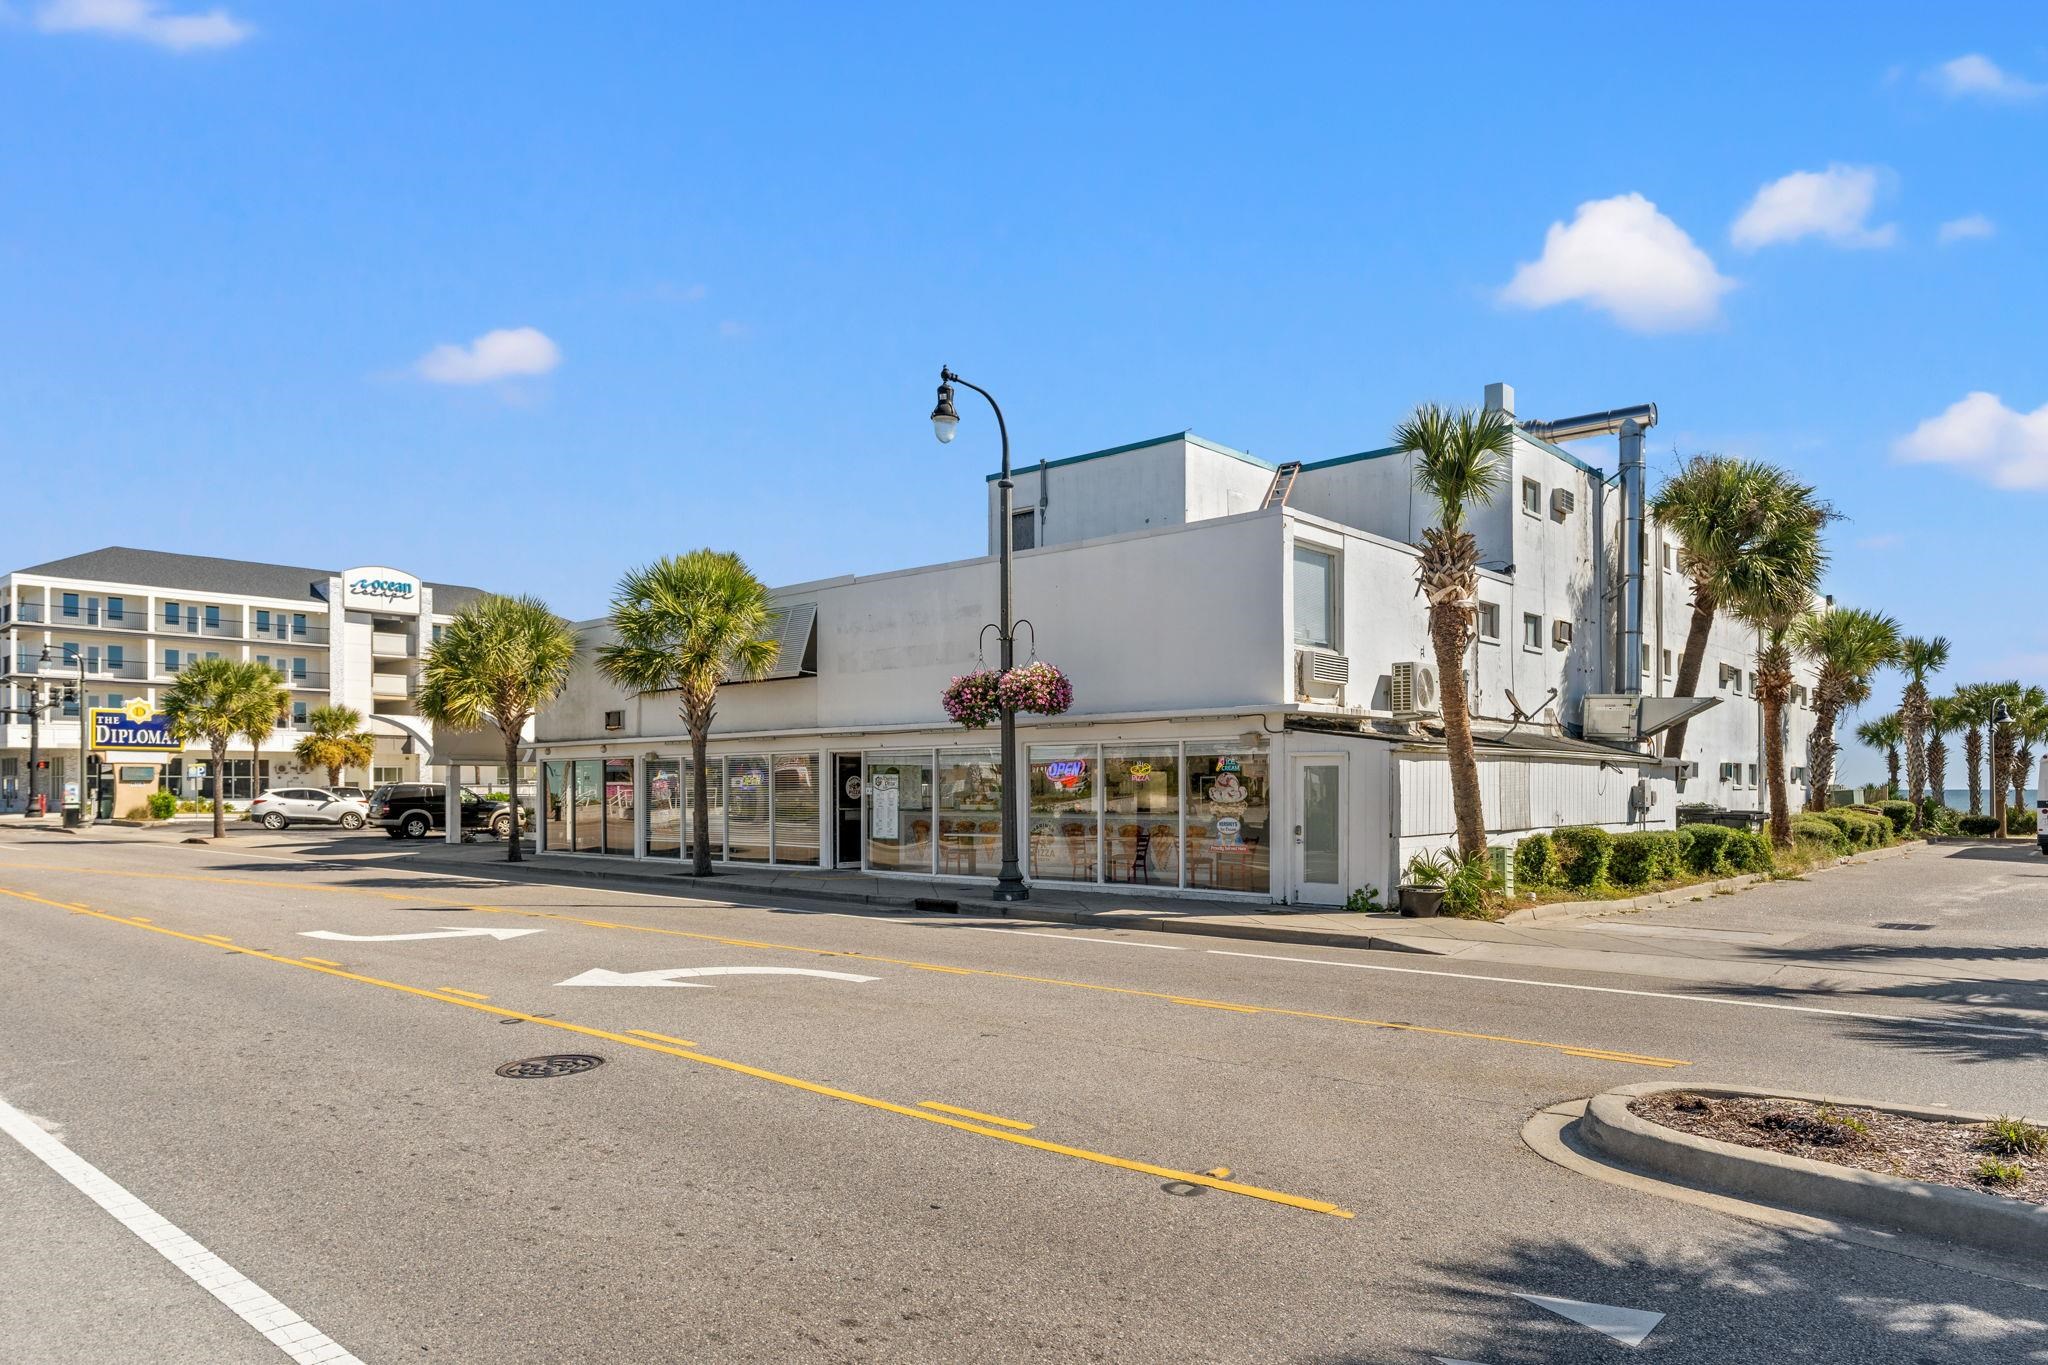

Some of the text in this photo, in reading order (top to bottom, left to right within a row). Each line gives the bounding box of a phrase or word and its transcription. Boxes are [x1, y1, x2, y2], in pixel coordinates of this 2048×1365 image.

[371, 580, 412, 594] ocean
[97, 715, 120, 724] THE
[1049, 761, 1081, 776] OPEN
[1131, 774, 1150, 782] PIZZA
